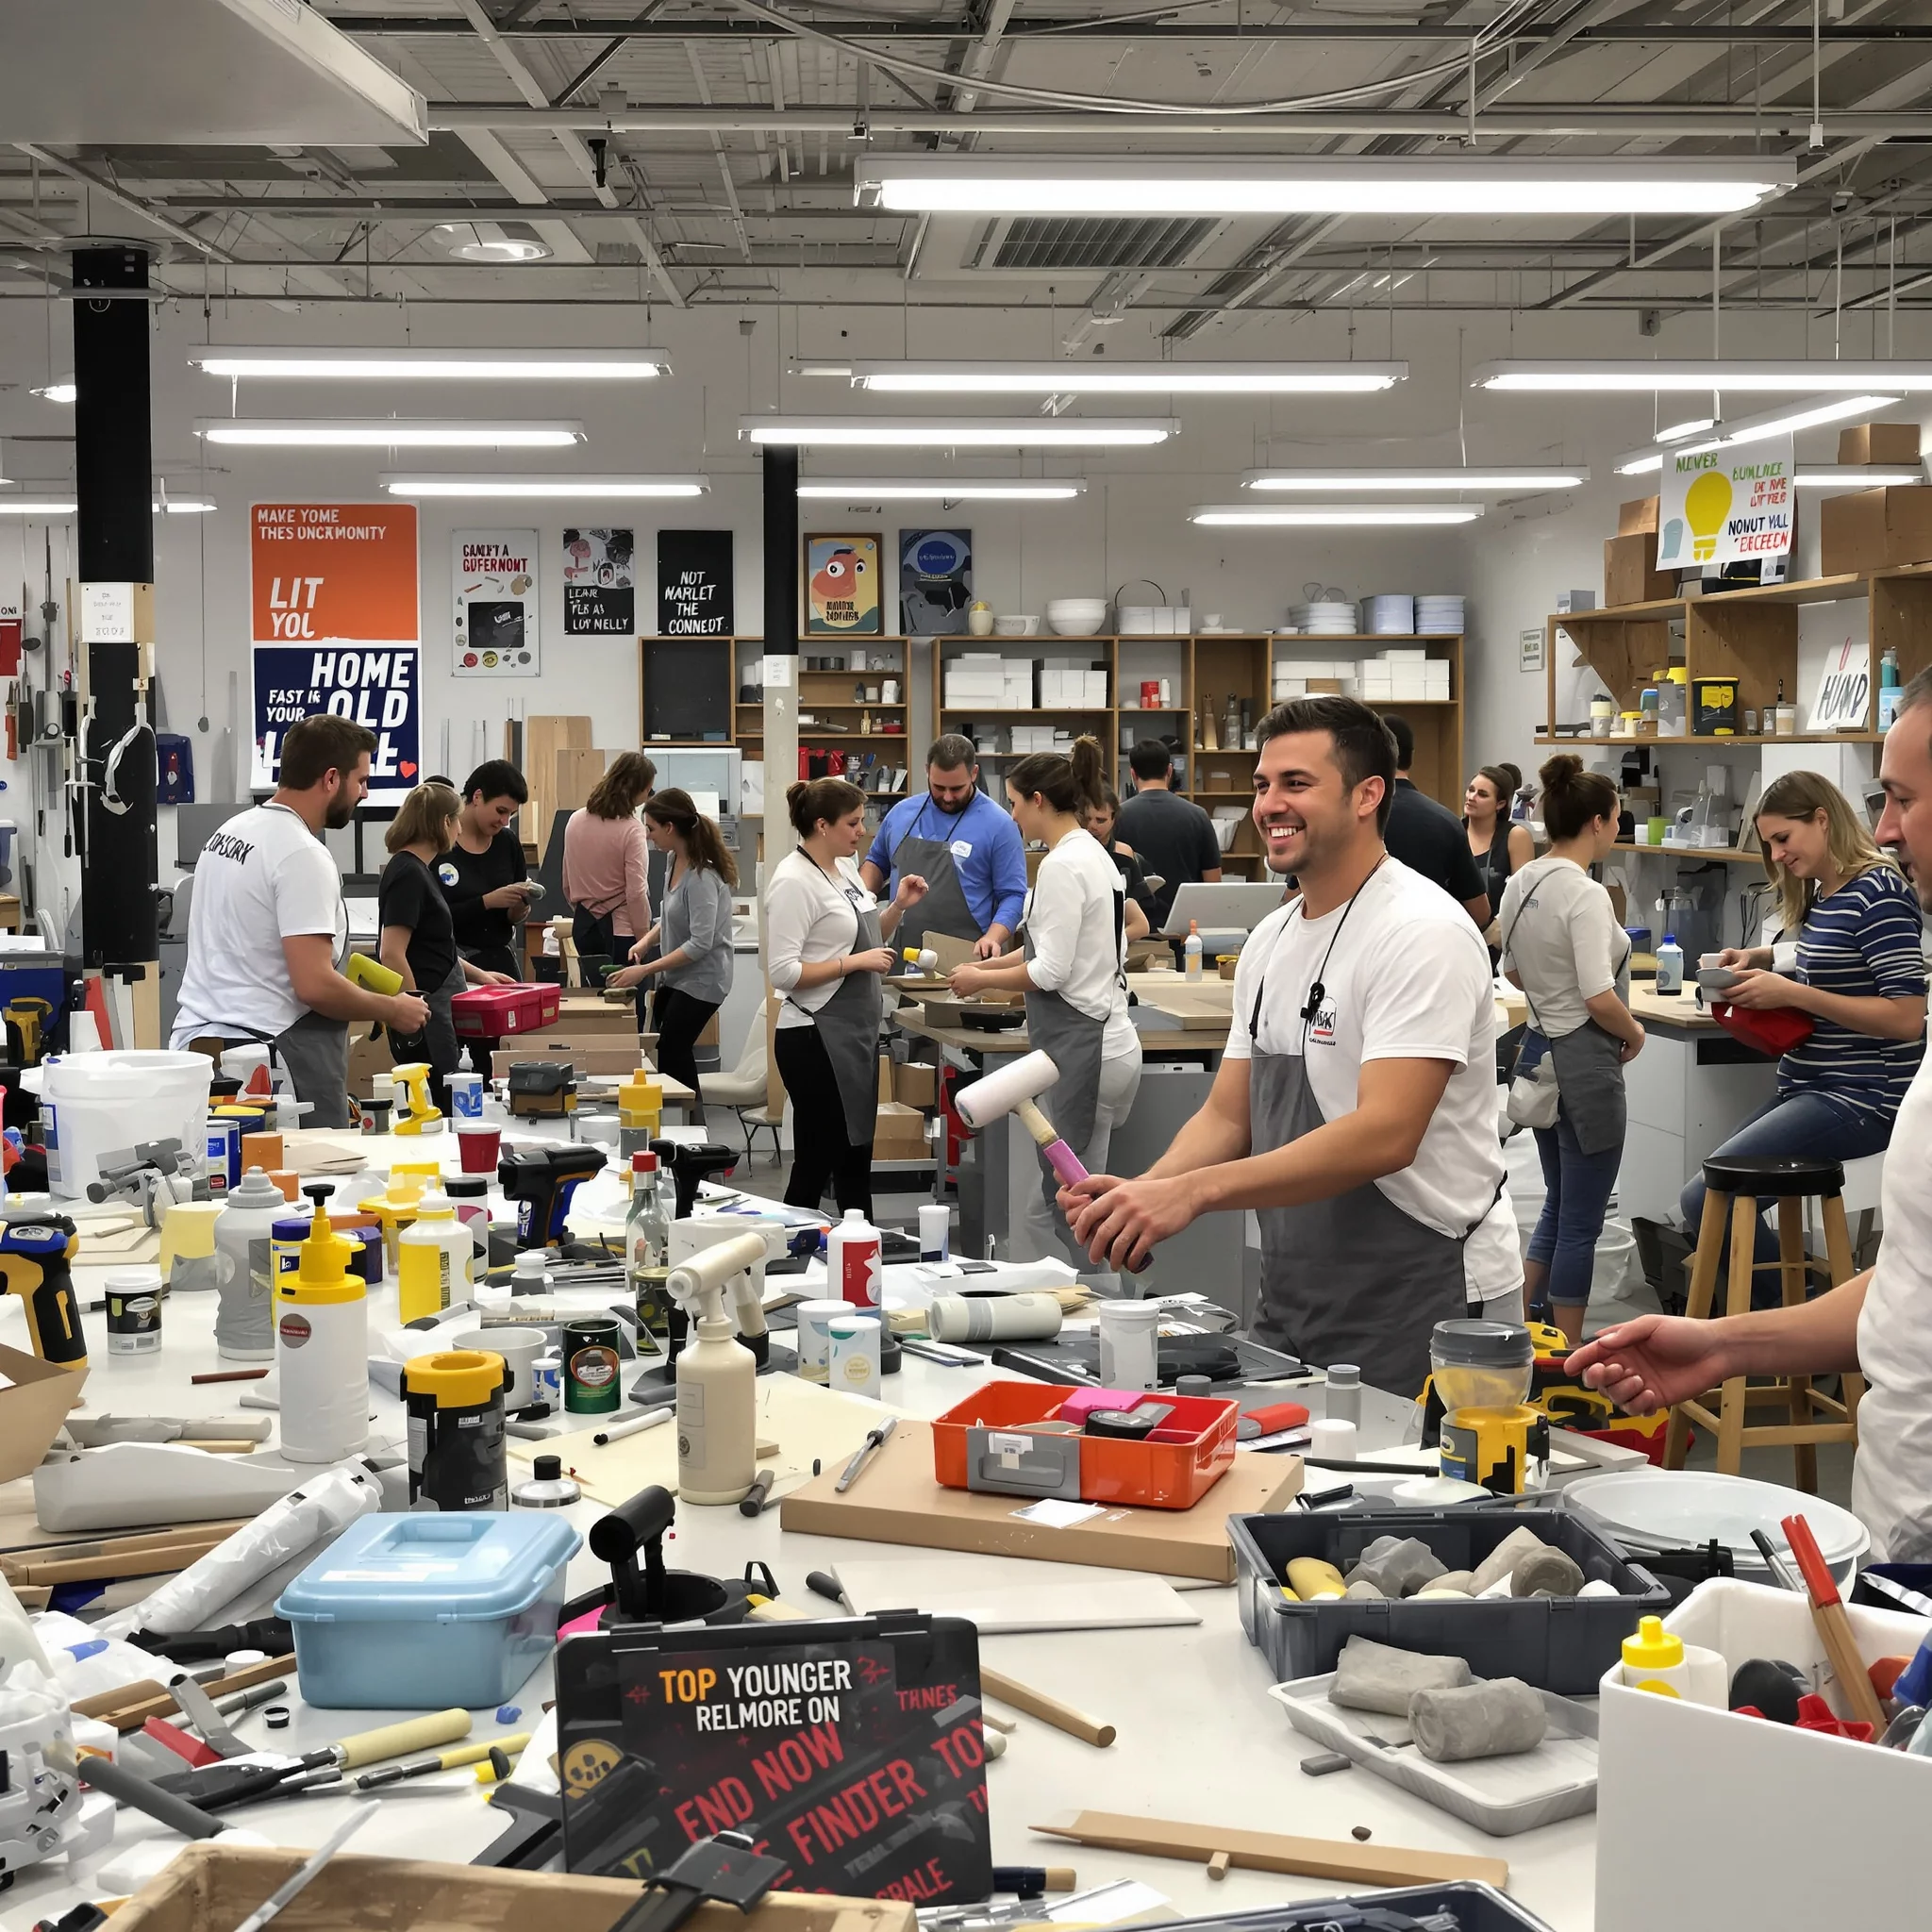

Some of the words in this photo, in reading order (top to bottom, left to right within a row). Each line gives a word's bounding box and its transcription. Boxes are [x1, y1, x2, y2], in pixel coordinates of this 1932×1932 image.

[258, 508, 296, 523] MAKE
[300, 508, 340, 523] YOME
[259, 525, 294, 540] THES
[680, 571, 707, 585] NOT
[270, 577, 325, 608] LIT
[675, 602, 699, 616] THE
[593, 618, 629, 630] NELLY
[310, 652, 413, 688] HOME
[269, 690, 305, 705] FAST
[267, 707, 306, 723] YOUR
[658, 1667, 717, 1705] TOP
[726, 1659, 852, 1698] YOUNGER
[695, 1698, 802, 1732] RELMORE
[808, 1695, 841, 1724] ON
[674, 1776, 754, 1844] END
[750, 1721, 844, 1801] NOW
[786, 1757, 928, 1866] FINDER
